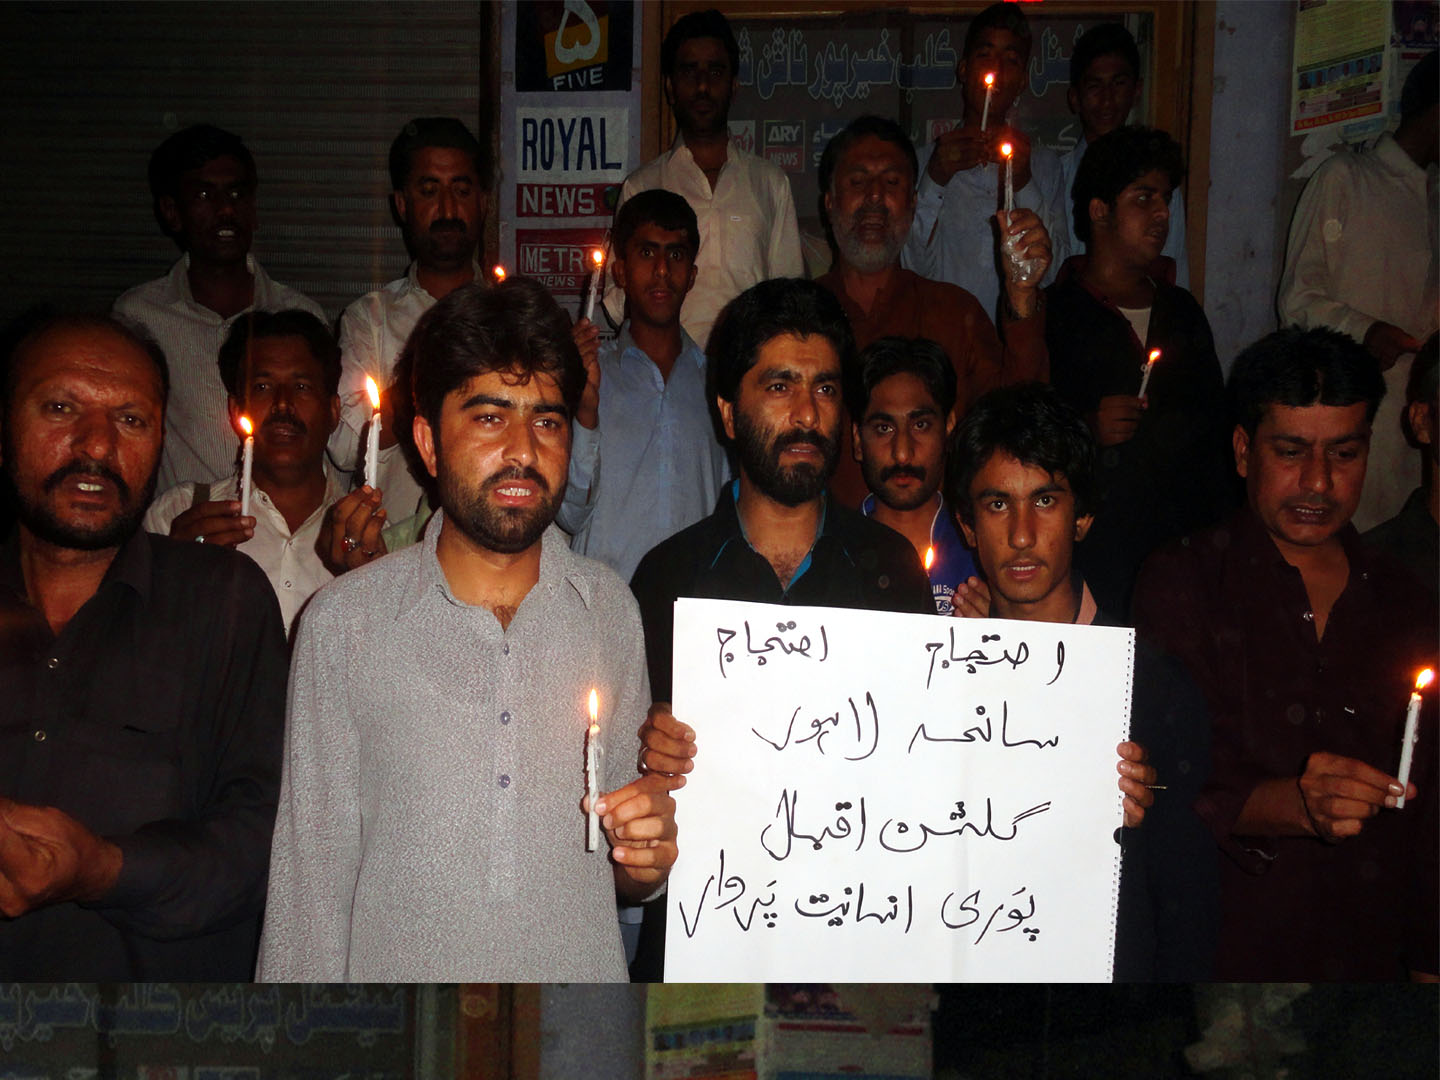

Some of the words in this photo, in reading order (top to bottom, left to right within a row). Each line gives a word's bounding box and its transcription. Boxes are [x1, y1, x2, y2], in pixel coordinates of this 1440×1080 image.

[553, 66, 604, 91] FIVE
[522, 117, 622, 171] ROYAL
[768, 125, 801, 142] ARY
[521, 186, 595, 214] NEWS
[524, 246, 597, 273] METR
[537, 275, 576, 287] NEWS
[751, 691, 879, 760] لاہور
[760, 788, 866, 860] اقبال
[879, 798, 1052, 852] گلشن
